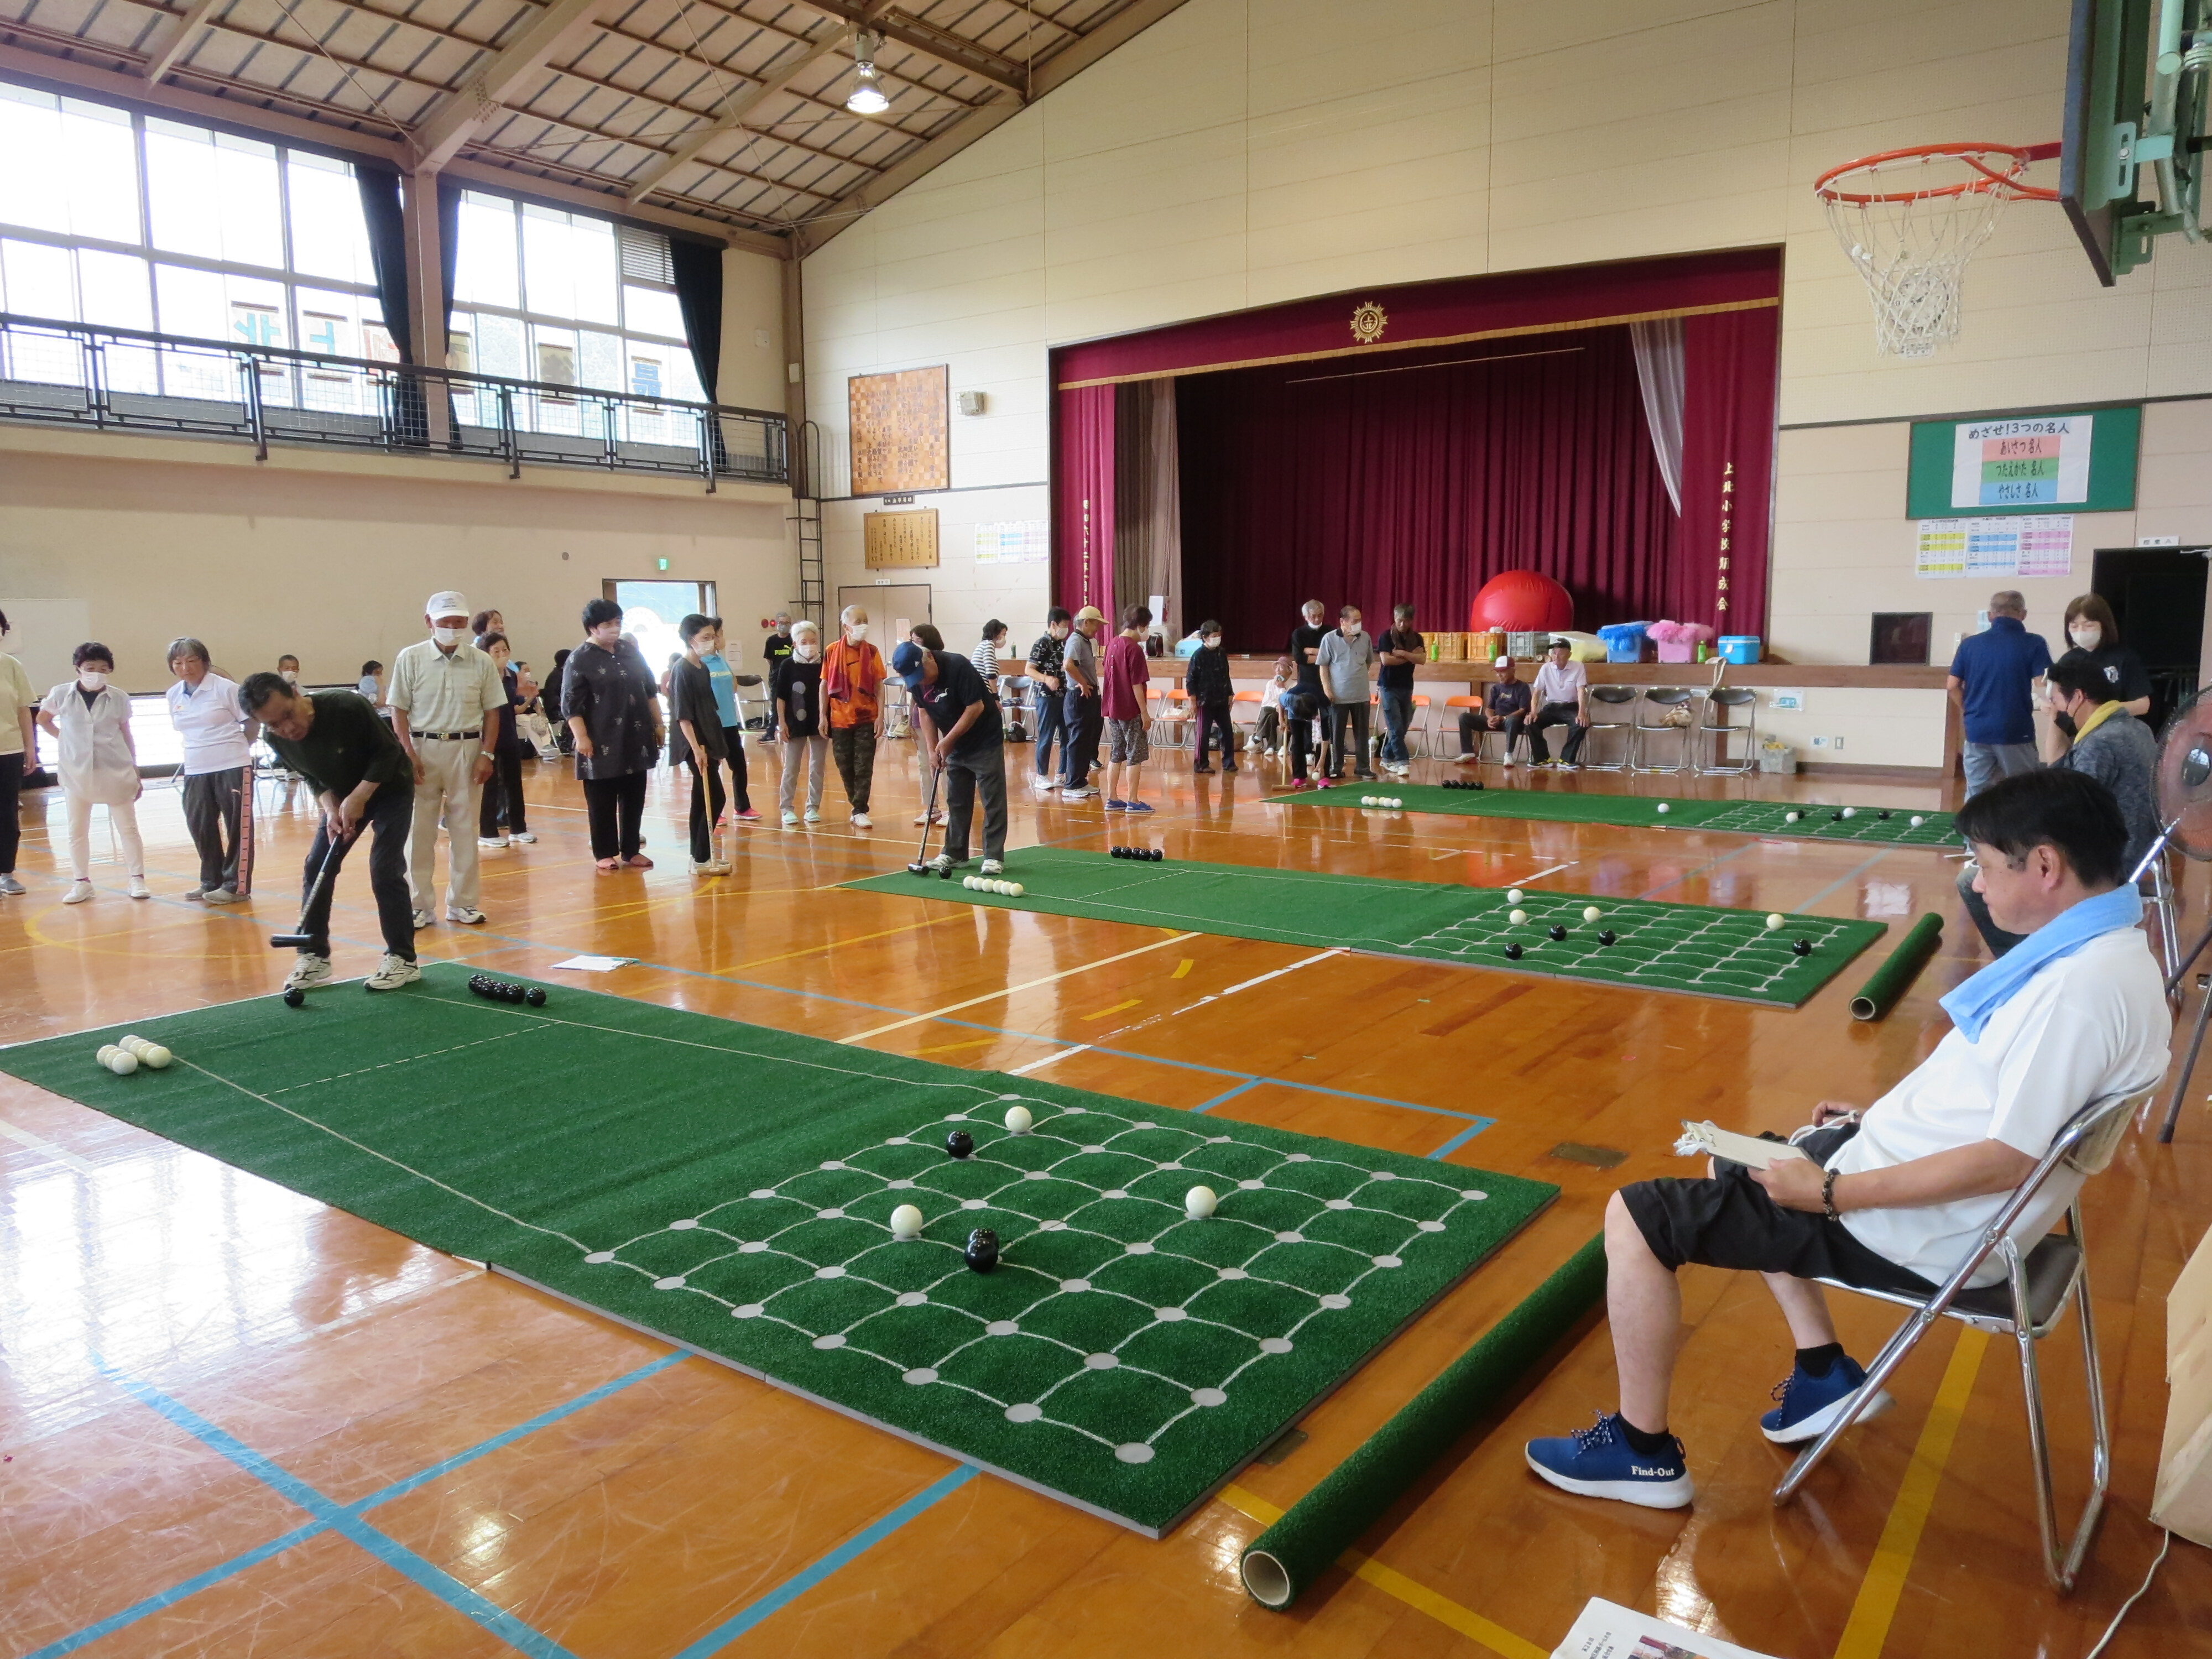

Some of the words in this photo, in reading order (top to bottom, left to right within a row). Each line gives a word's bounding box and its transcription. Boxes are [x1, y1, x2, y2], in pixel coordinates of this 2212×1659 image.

[2029, 438, 2042, 453] 名人
[1996, 461, 2027, 477] つたえかた
[2031, 460, 2044, 476] 名人
[1998, 483, 2022, 499] やさしさ
[2025, 482, 2038, 498] 名人
[1631, 1465, 1675, 1477] Find-Out
